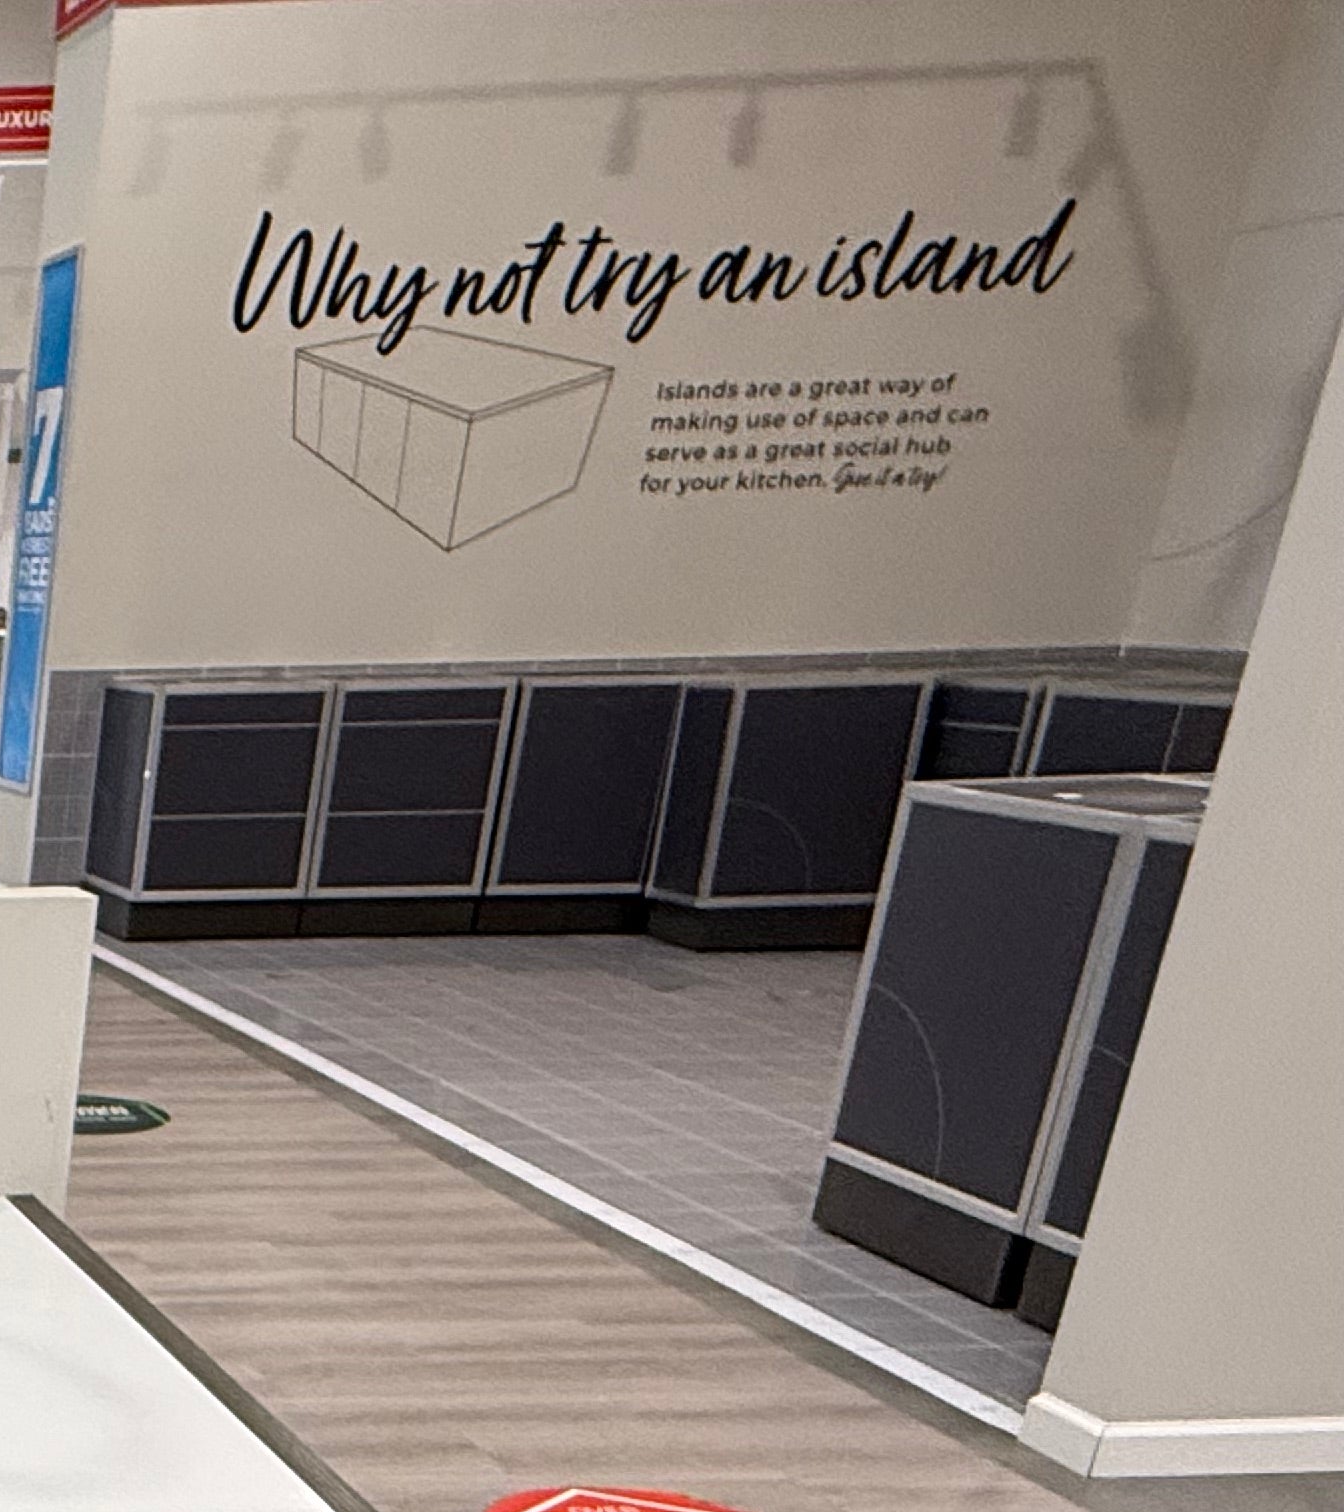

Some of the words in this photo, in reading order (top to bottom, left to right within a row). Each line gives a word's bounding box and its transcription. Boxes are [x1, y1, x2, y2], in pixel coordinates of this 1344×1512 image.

[232, 210, 440, 357] Why
[443, 221, 567, 325] not
[562, 226, 691, 344] try
[698, 243, 809, 304] an
[815, 197, 1078, 301] island
[656, 379, 739, 401] Islands
[744, 380, 782, 398] are
[787, 380, 802, 398] a
[808, 378, 871, 401] great
[878, 378, 925, 398] way
[930, 372, 957, 393] of
[651, 409, 739, 434] making
[745, 412, 786, 429] use
[792, 406, 818, 428] of
[822, 409, 889, 432] space
[896, 404, 941, 428] and
[947, 406, 989, 425] can
[644, 445, 708, 463] serve
[713, 443, 739, 461] as
[744, 443, 758, 460] a
[764, 441, 825, 464] great
[831, 435, 899, 457] social
[905, 433, 951, 456] hub
[640, 471, 673, 493] for
[675, 474, 731, 497] your
[735, 468, 828, 491] kitchen.
